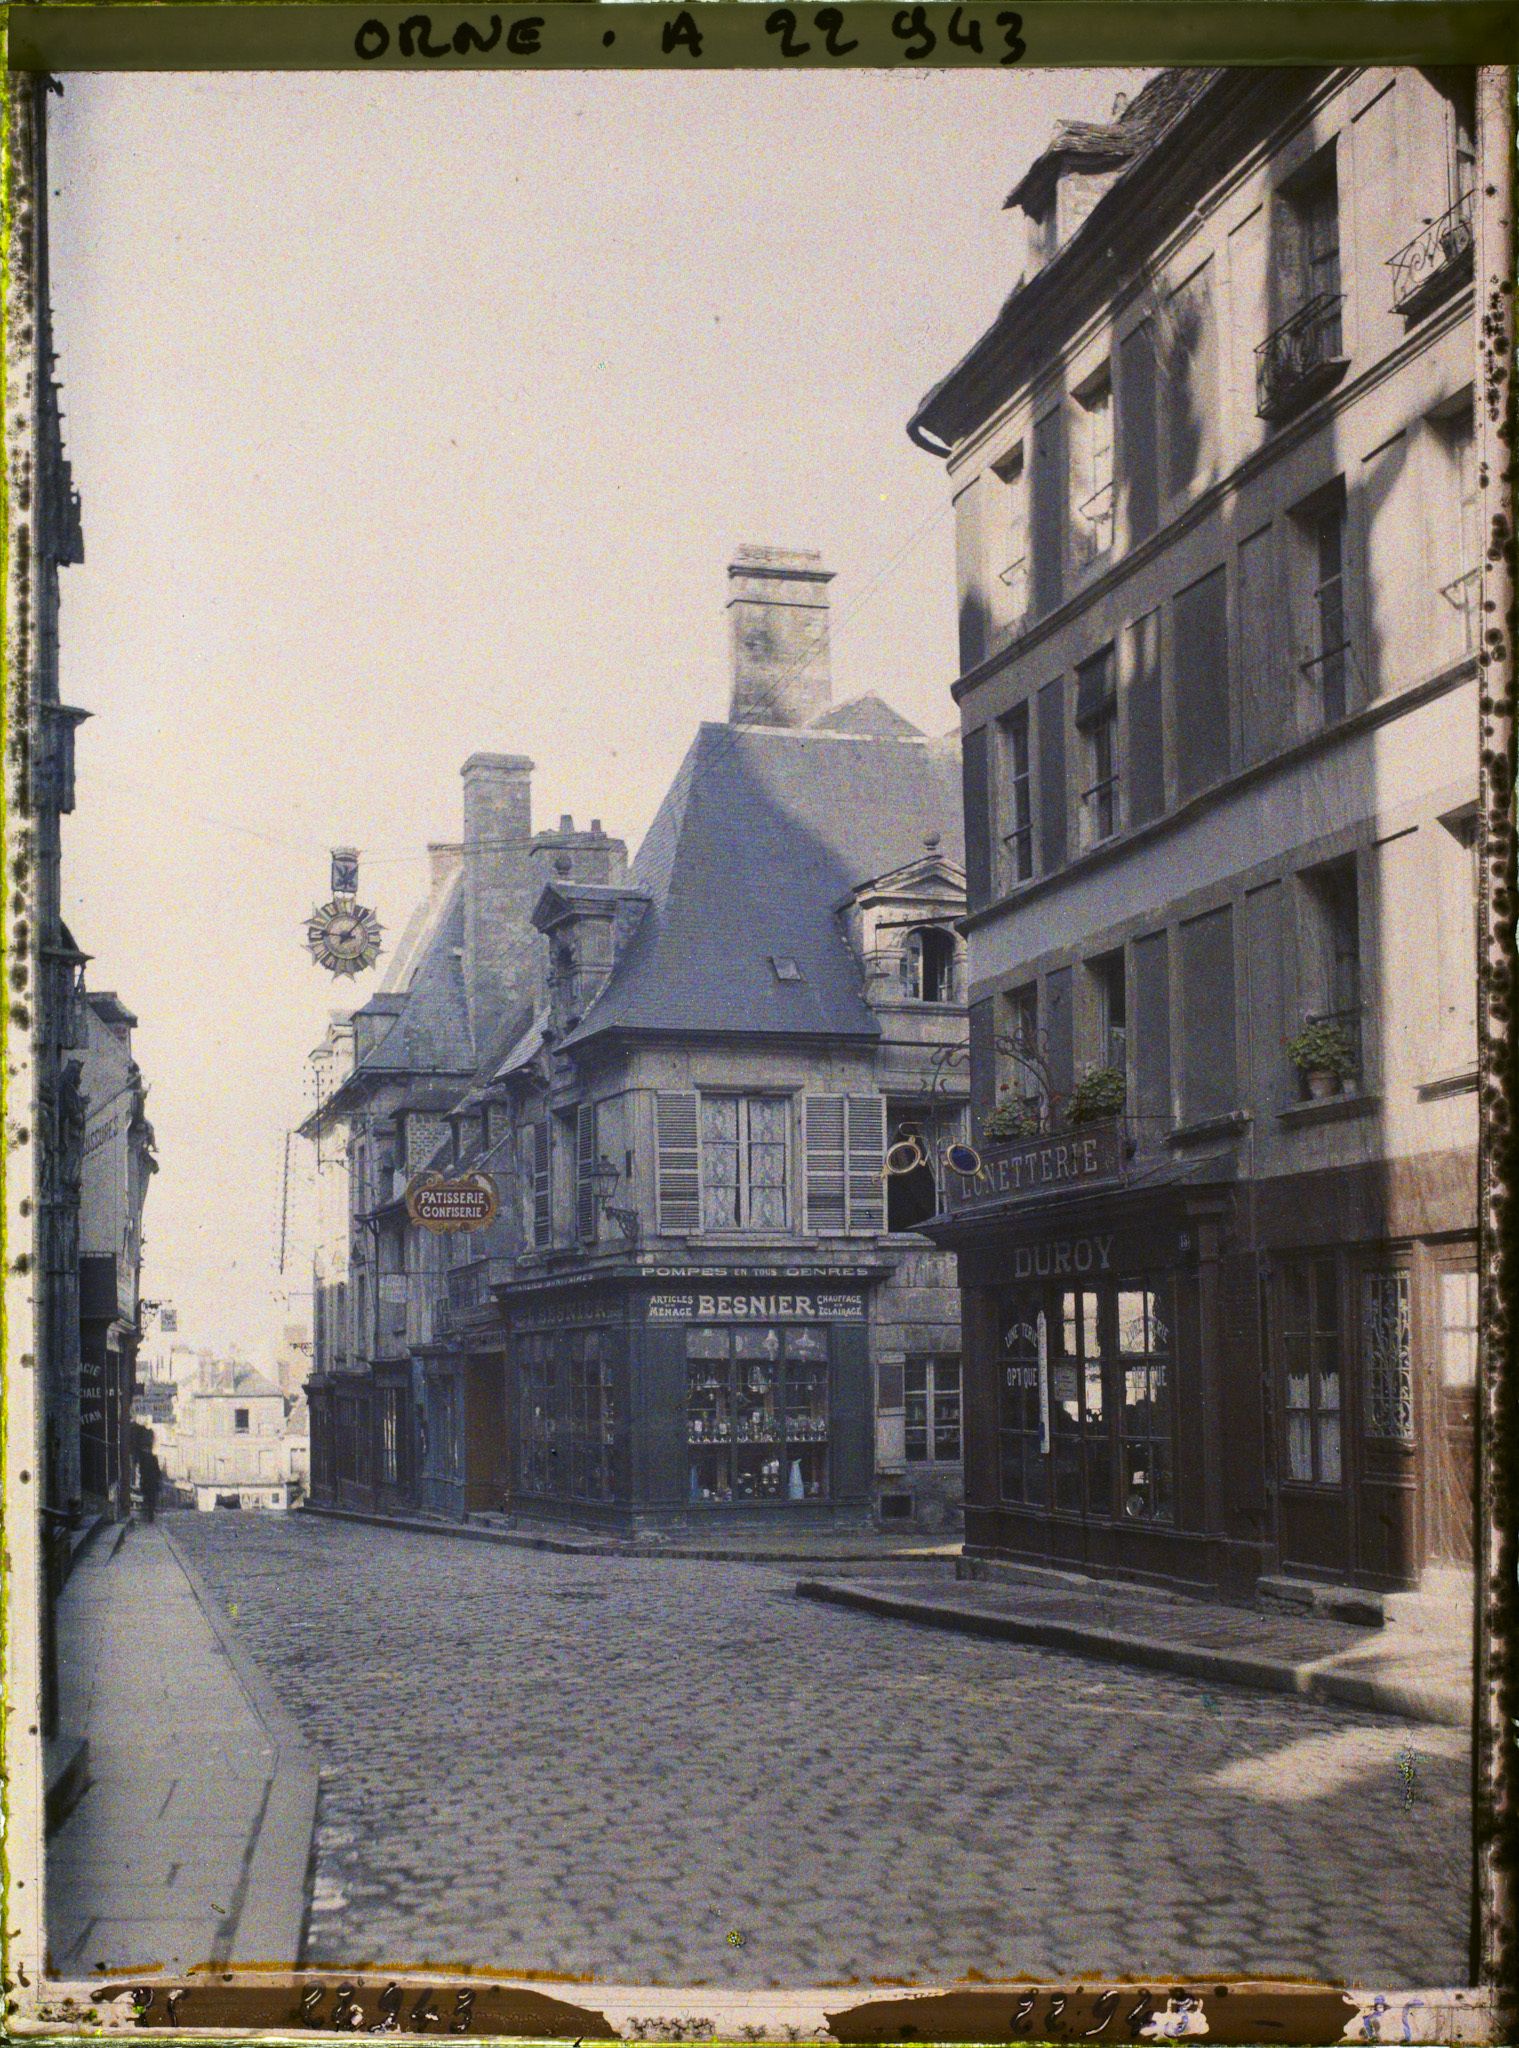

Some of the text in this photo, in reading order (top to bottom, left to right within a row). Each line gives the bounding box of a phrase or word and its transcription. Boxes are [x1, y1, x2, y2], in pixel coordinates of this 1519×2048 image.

[354, 16, 544, 59] ORNE
[662, 12, 703, 57] A
[961, 1139, 1098, 1199] LUNETTERIE
[421, 1191, 485, 1204] PATISSERIE
[422, 1205, 482, 1218] CONFISERIE
[1014, 1234, 1114, 1279] DUROY
[641, 1267, 868, 1277] POMPES EN TOUS GENRES
[650, 1295, 694, 1305] ARTICLES
[698, 1295, 815, 1316] BESNIER
[816, 1294, 862, 1305] CHAUFFAGE
[1006, 1367, 1038, 1388] OPTQUE
